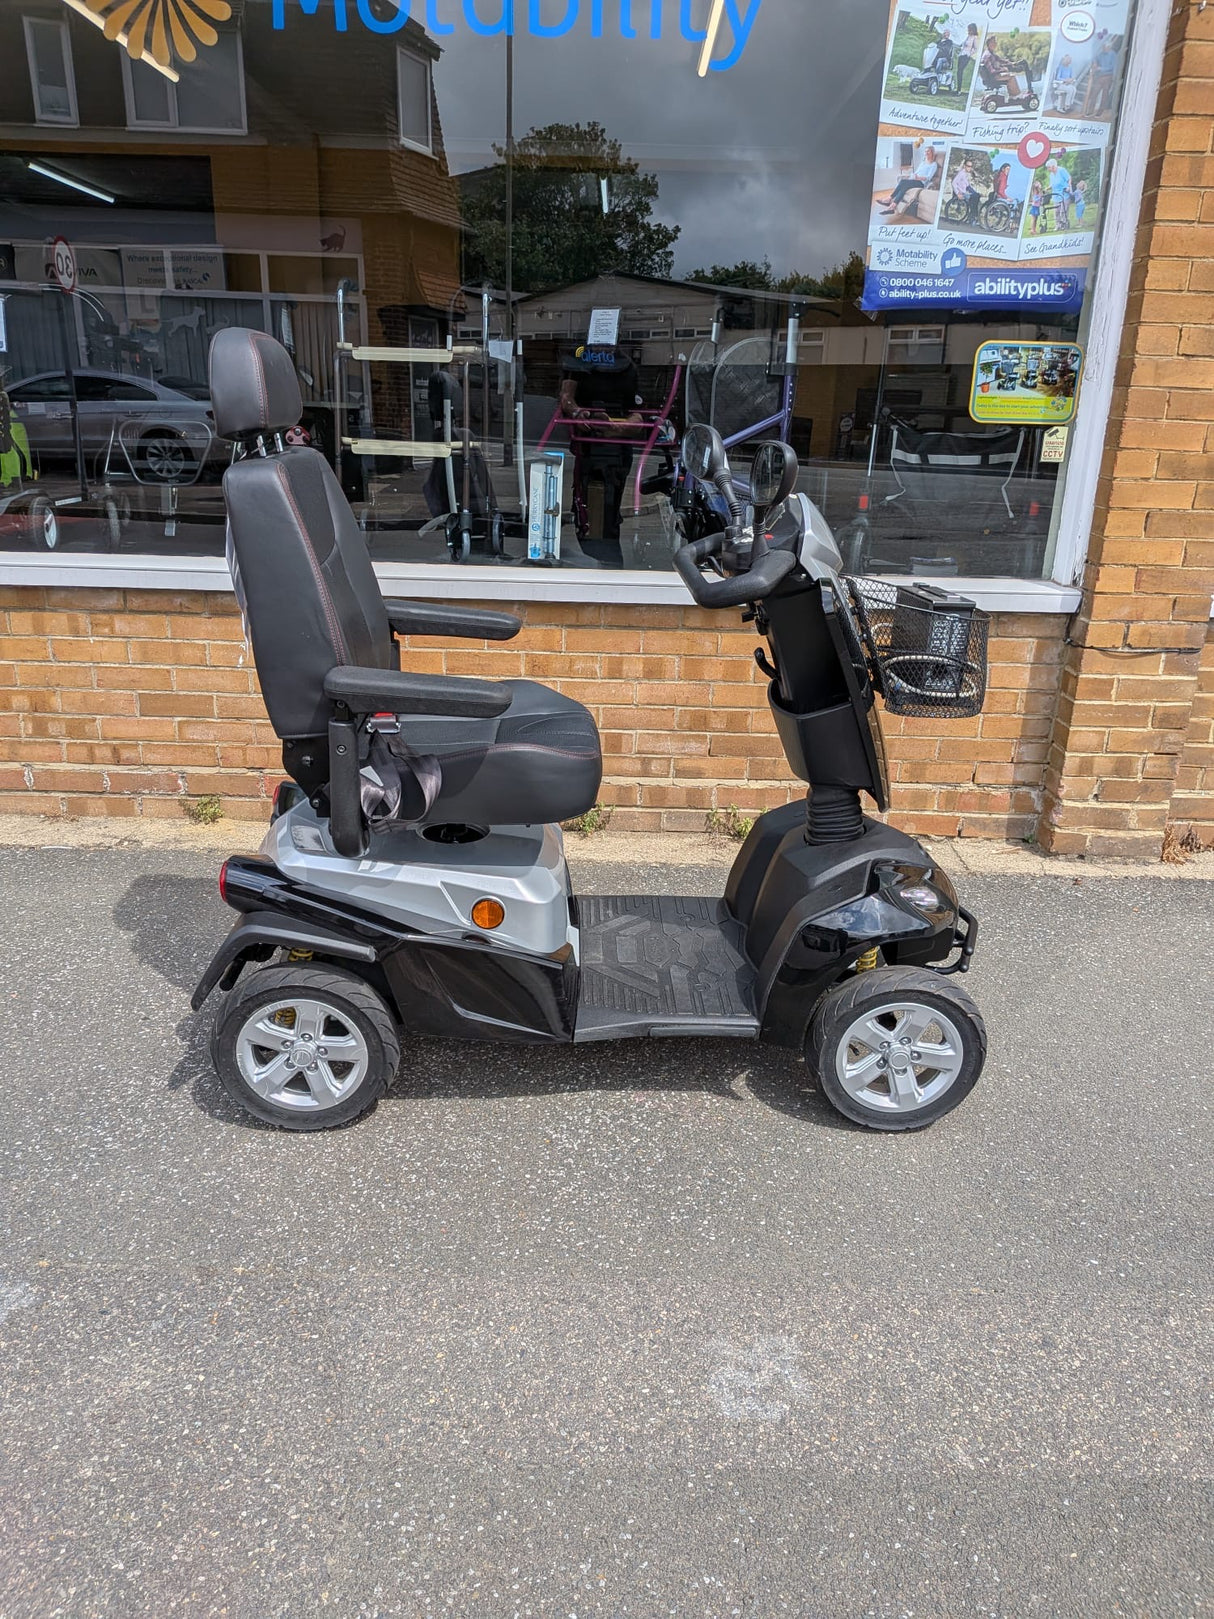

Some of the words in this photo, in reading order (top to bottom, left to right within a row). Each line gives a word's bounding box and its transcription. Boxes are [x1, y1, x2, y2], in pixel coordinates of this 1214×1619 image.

[888, 106, 928, 122] Adventure
[972, 125, 1005, 141] Fishing
[1006, 121, 1030, 136] trip?
[1038, 121, 1064, 137] Finally
[1064, 123, 1076, 133] sort
[1077, 124, 1105, 136] upstairs
[878, 226, 897, 238] Put
[895, 226, 915, 242] feet
[915, 229, 931, 243] up!
[942, 232, 955, 246] Go
[955, 237, 976, 248] more
[895, 248, 938, 262] Motability
[1023, 243, 1038, 254] See
[151, 254, 192, 263] exctional
[895, 258, 927, 268] Scheme
[889, 277, 914, 287] 0800
[914, 278, 933, 287] 046
[934, 278, 955, 287] 1647
[974, 277, 1064, 299] abilityplus
[888, 288, 962, 300] ability-plus.co.uk
[581, 349, 615, 363] alerta
[1042, 450, 1064, 458] CCTV
